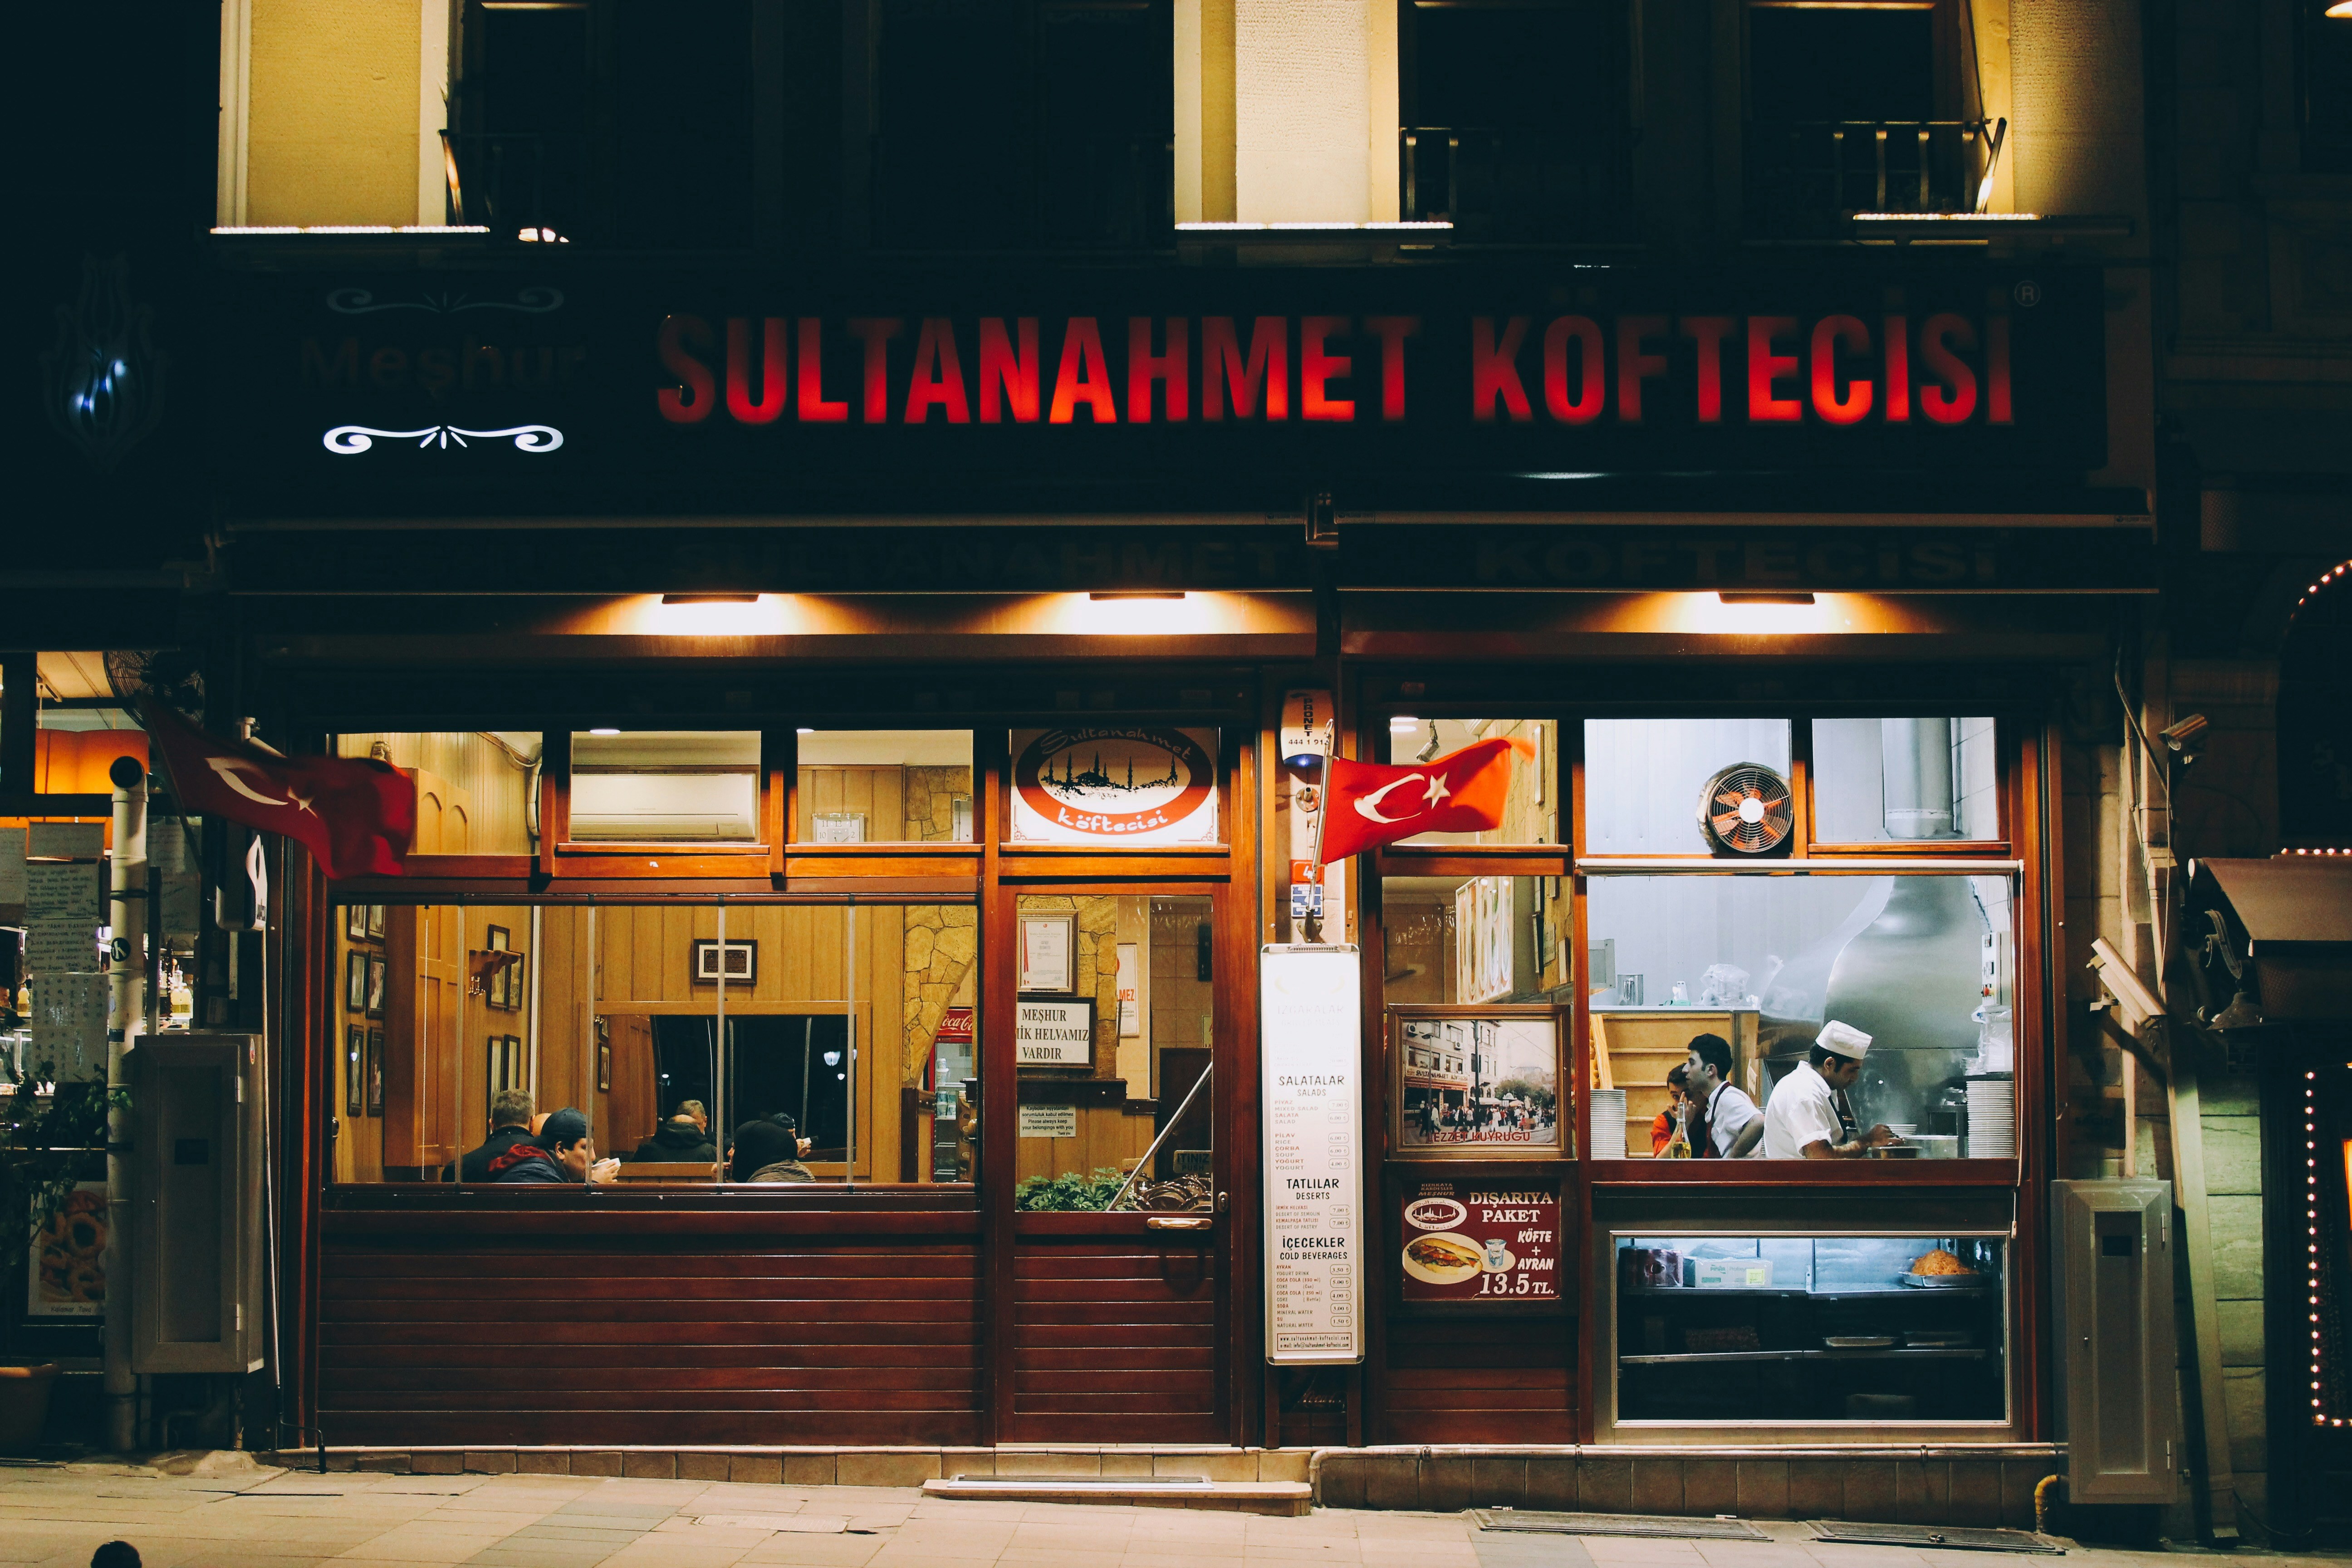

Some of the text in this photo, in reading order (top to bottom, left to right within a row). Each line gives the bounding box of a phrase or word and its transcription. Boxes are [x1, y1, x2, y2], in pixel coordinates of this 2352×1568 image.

[657, 315, 1421, 425] SULTANAHMET
[1303, 698, 1313, 736] PRONET
[1040, 728, 1191, 760] Sultanahmet
[1058, 807, 1168, 832] köftecisi
[1117, 989, 1134, 1002] MEZ
[1022, 1009, 1067, 1024] MEŞHUR
[1035, 1028, 1089, 1041] HELVAMIZ
[1022, 1047, 1062, 1059] VARDIR
[1279, 1076, 1345, 1086] SALATALAR
[1427, 1132, 1468, 1143] LEZZET
[1287, 1179, 1339, 1189] TATLILAR
[1470, 1192, 1553, 1208] DIŞARIYA
[1482, 1210, 1540, 1222] PAKET
[1283, 1235, 1345, 1250] İÇECEKLER
[1517, 1228, 1552, 1243] KÖFTE
[1518, 1258, 1554, 1270] AYRAN
[1480, 1273, 1554, 1294] 13.5 TL.
